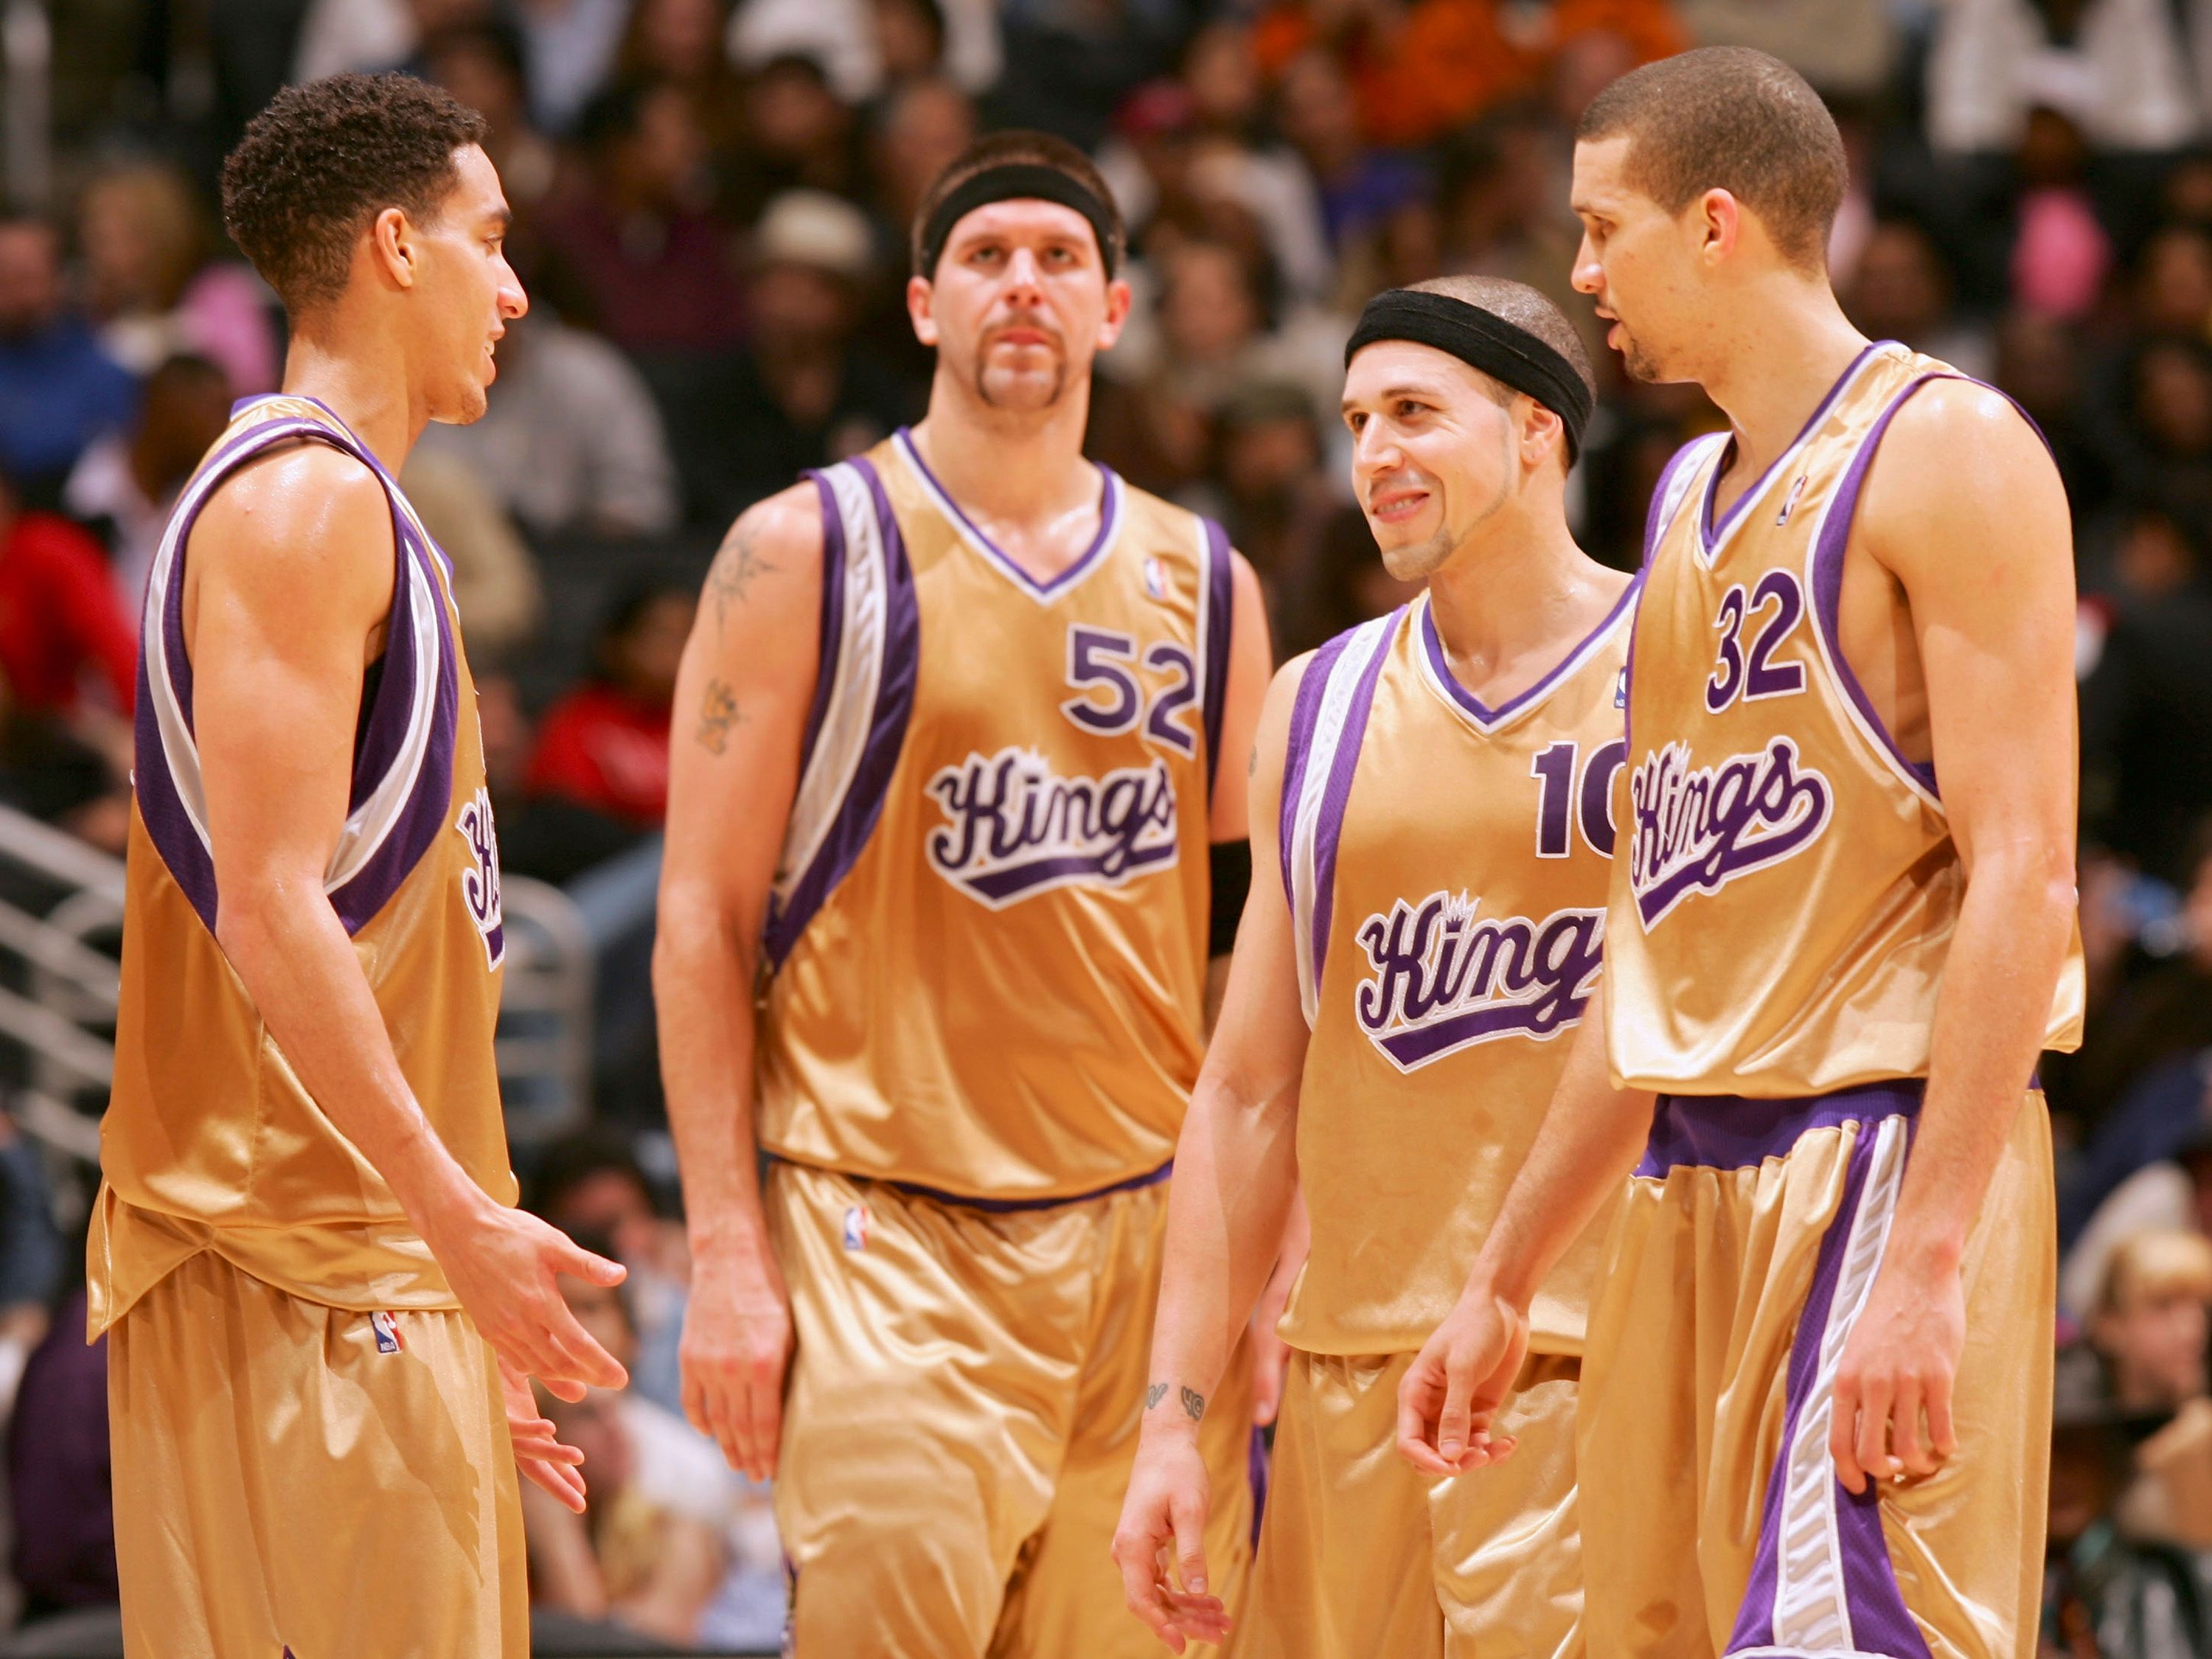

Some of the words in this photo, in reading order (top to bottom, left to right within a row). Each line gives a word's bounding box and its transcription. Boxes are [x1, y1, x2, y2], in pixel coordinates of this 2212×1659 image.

[1060, 624, 1197, 760] 52
[1705, 567, 1806, 714] 32
[1631, 735, 1833, 934] Kings
[1355, 888, 1608, 1074] King
